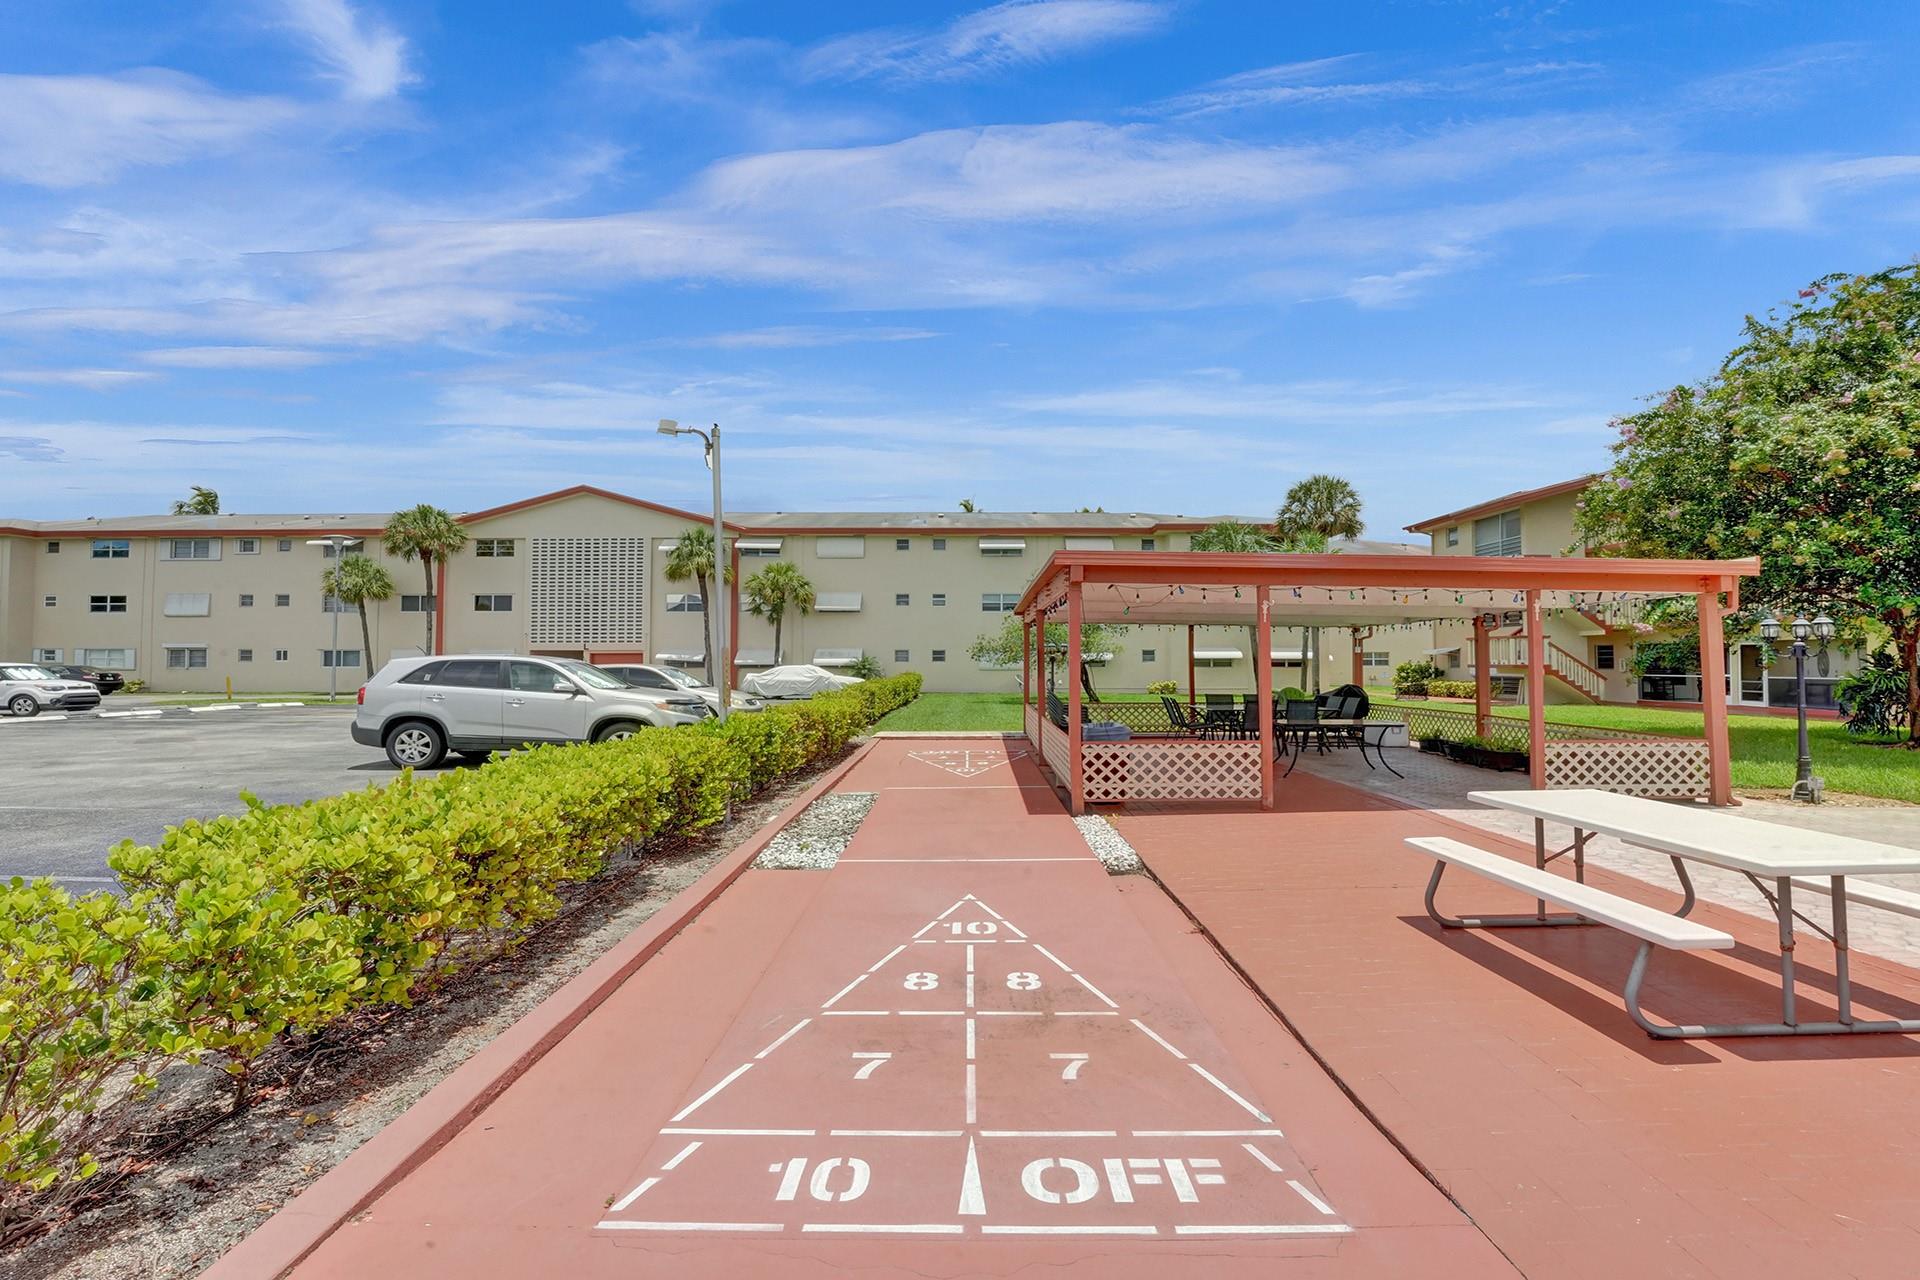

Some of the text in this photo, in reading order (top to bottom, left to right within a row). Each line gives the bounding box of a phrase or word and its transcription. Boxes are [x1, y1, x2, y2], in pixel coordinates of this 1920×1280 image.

[943, 921, 998, 935] 10
[903, 972, 939, 991] 8
[1006, 972, 1042, 991] 8
[852, 1052, 892, 1080] 7
[1049, 1053, 1089, 1080] 7
[768, 1157, 1226, 1204] 10 OFF
